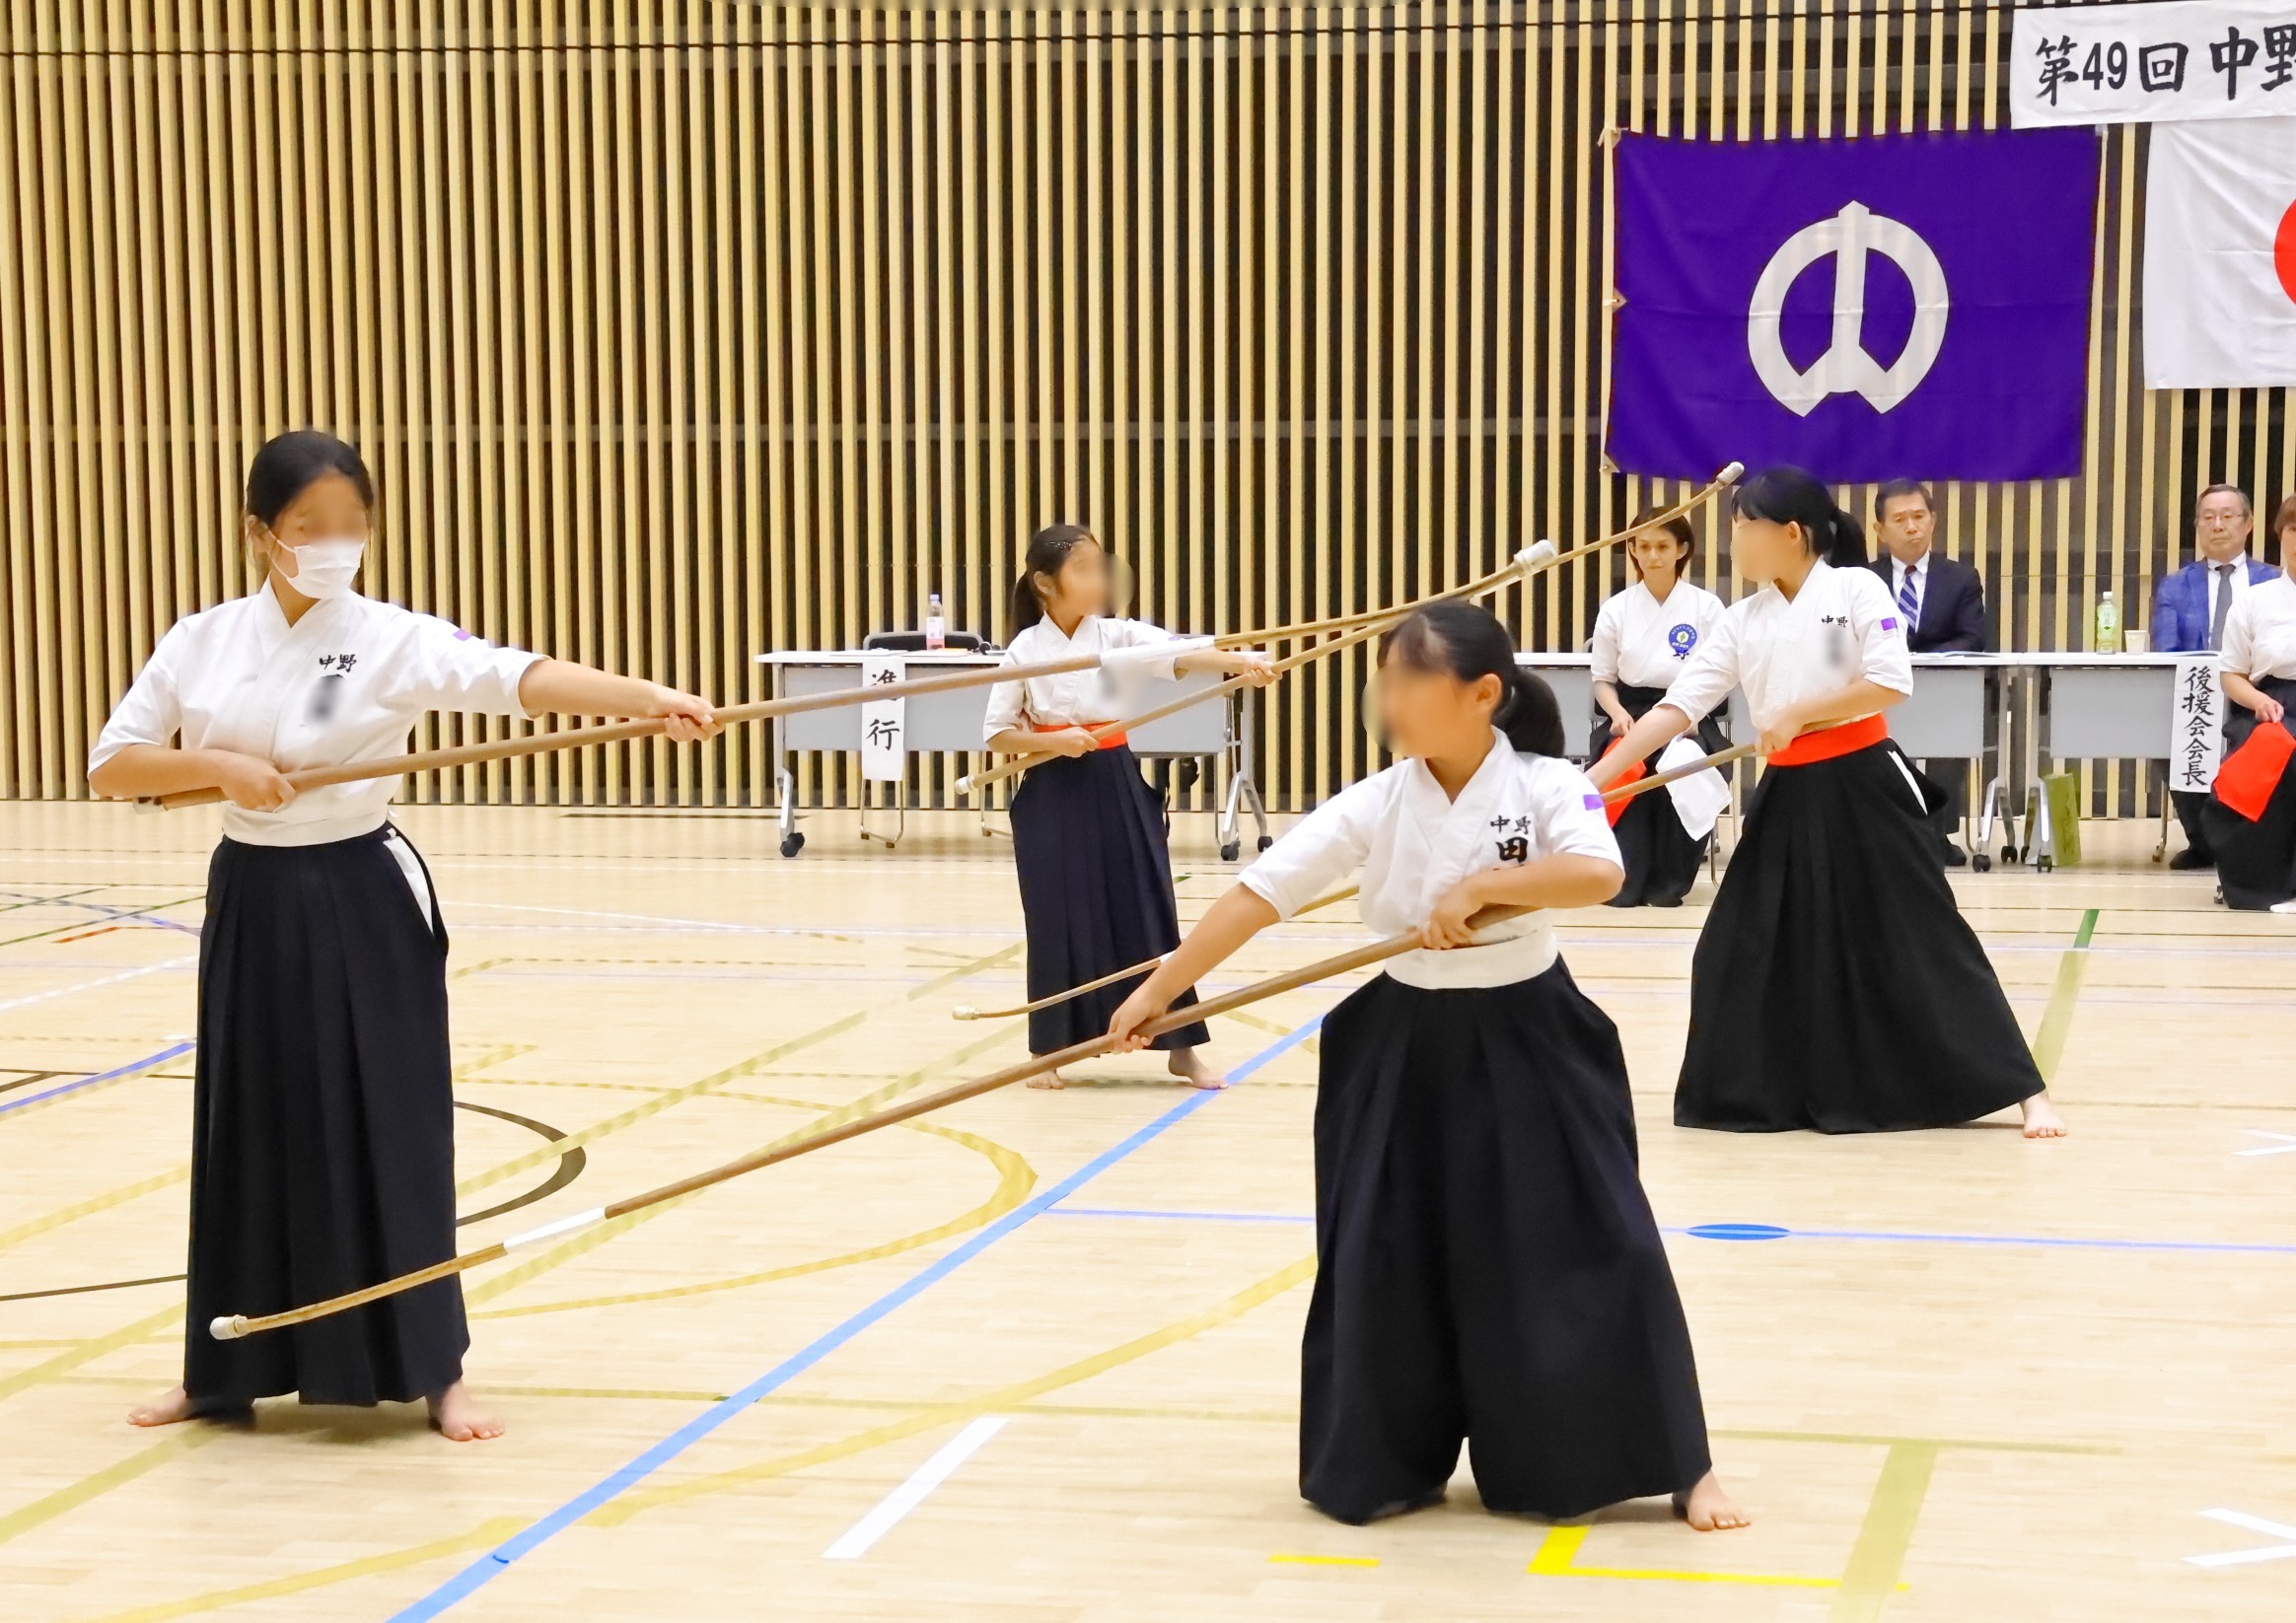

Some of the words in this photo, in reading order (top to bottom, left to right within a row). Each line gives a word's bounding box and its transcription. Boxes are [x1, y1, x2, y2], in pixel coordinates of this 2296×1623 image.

[2036, 35, 2189, 106] 第49回
[1821, 614, 1848, 628] 中野
[319, 654, 357, 672] 中野
[2182, 666, 2215, 786] 後援会会長
[1490, 814, 1531, 835] 中野
[1493, 836, 1529, 871] 田
